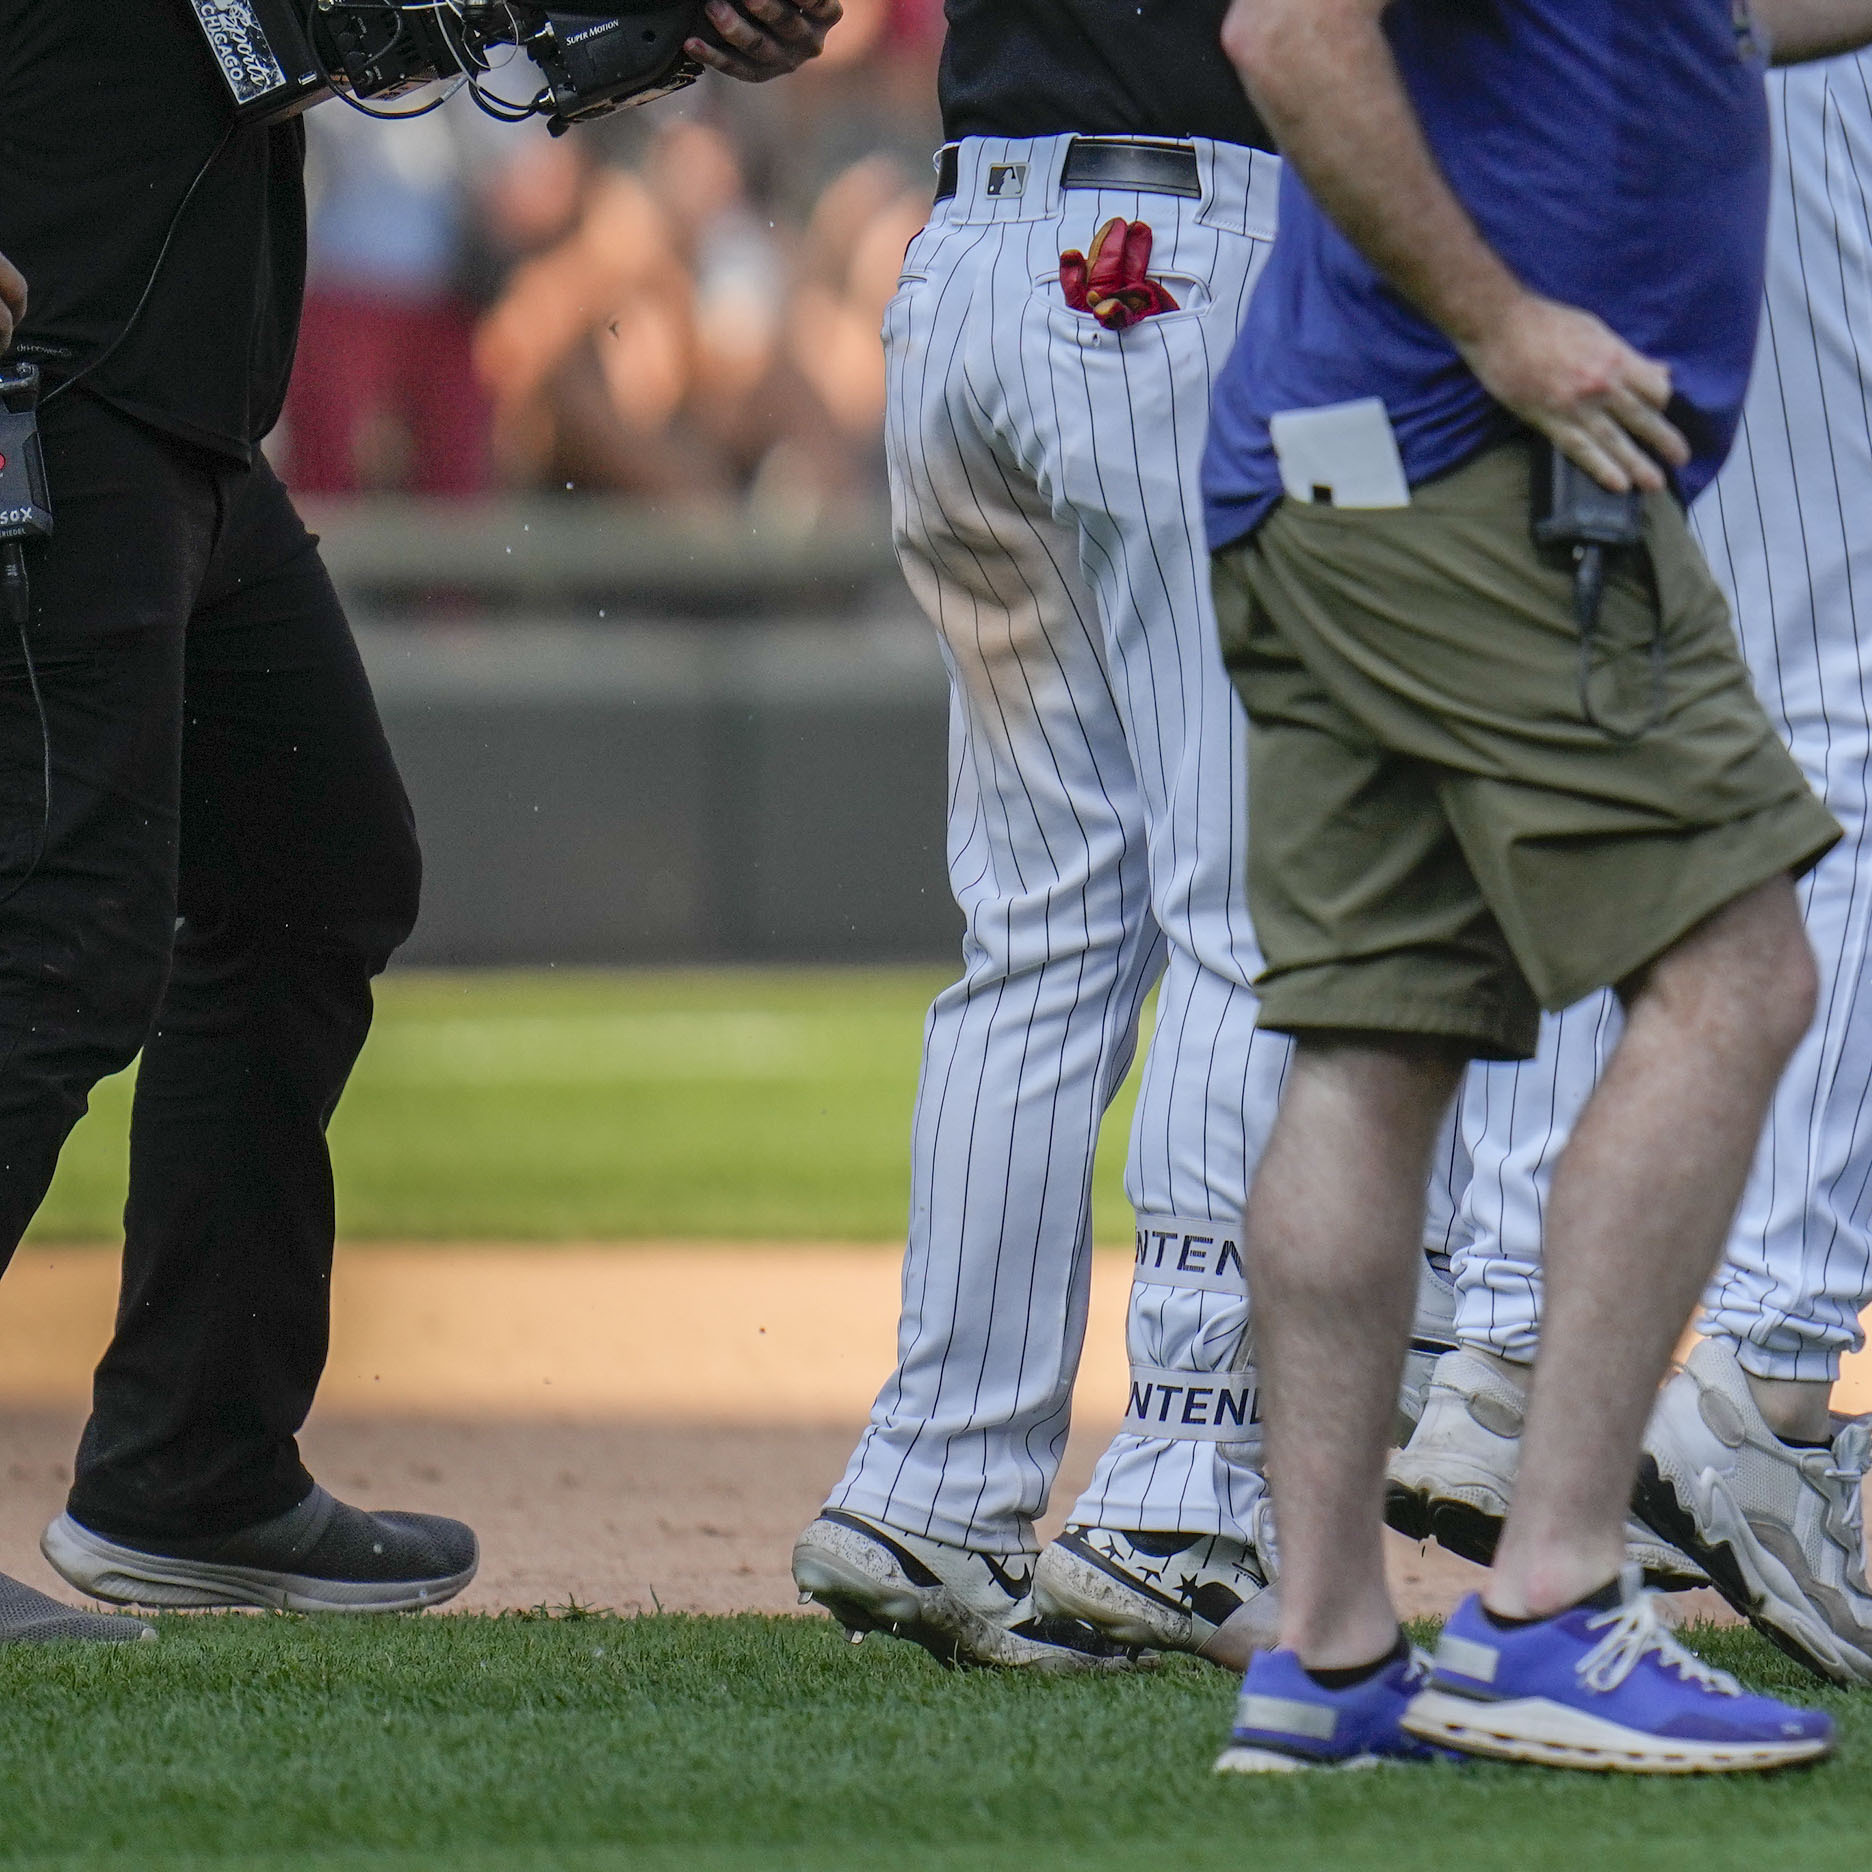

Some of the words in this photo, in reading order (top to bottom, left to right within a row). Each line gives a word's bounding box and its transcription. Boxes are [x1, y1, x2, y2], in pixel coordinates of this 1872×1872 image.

[200, 4, 244, 81] CHICAGO
[566, 32, 588, 46] SUPER
[589, 19, 619, 37] MOTION
